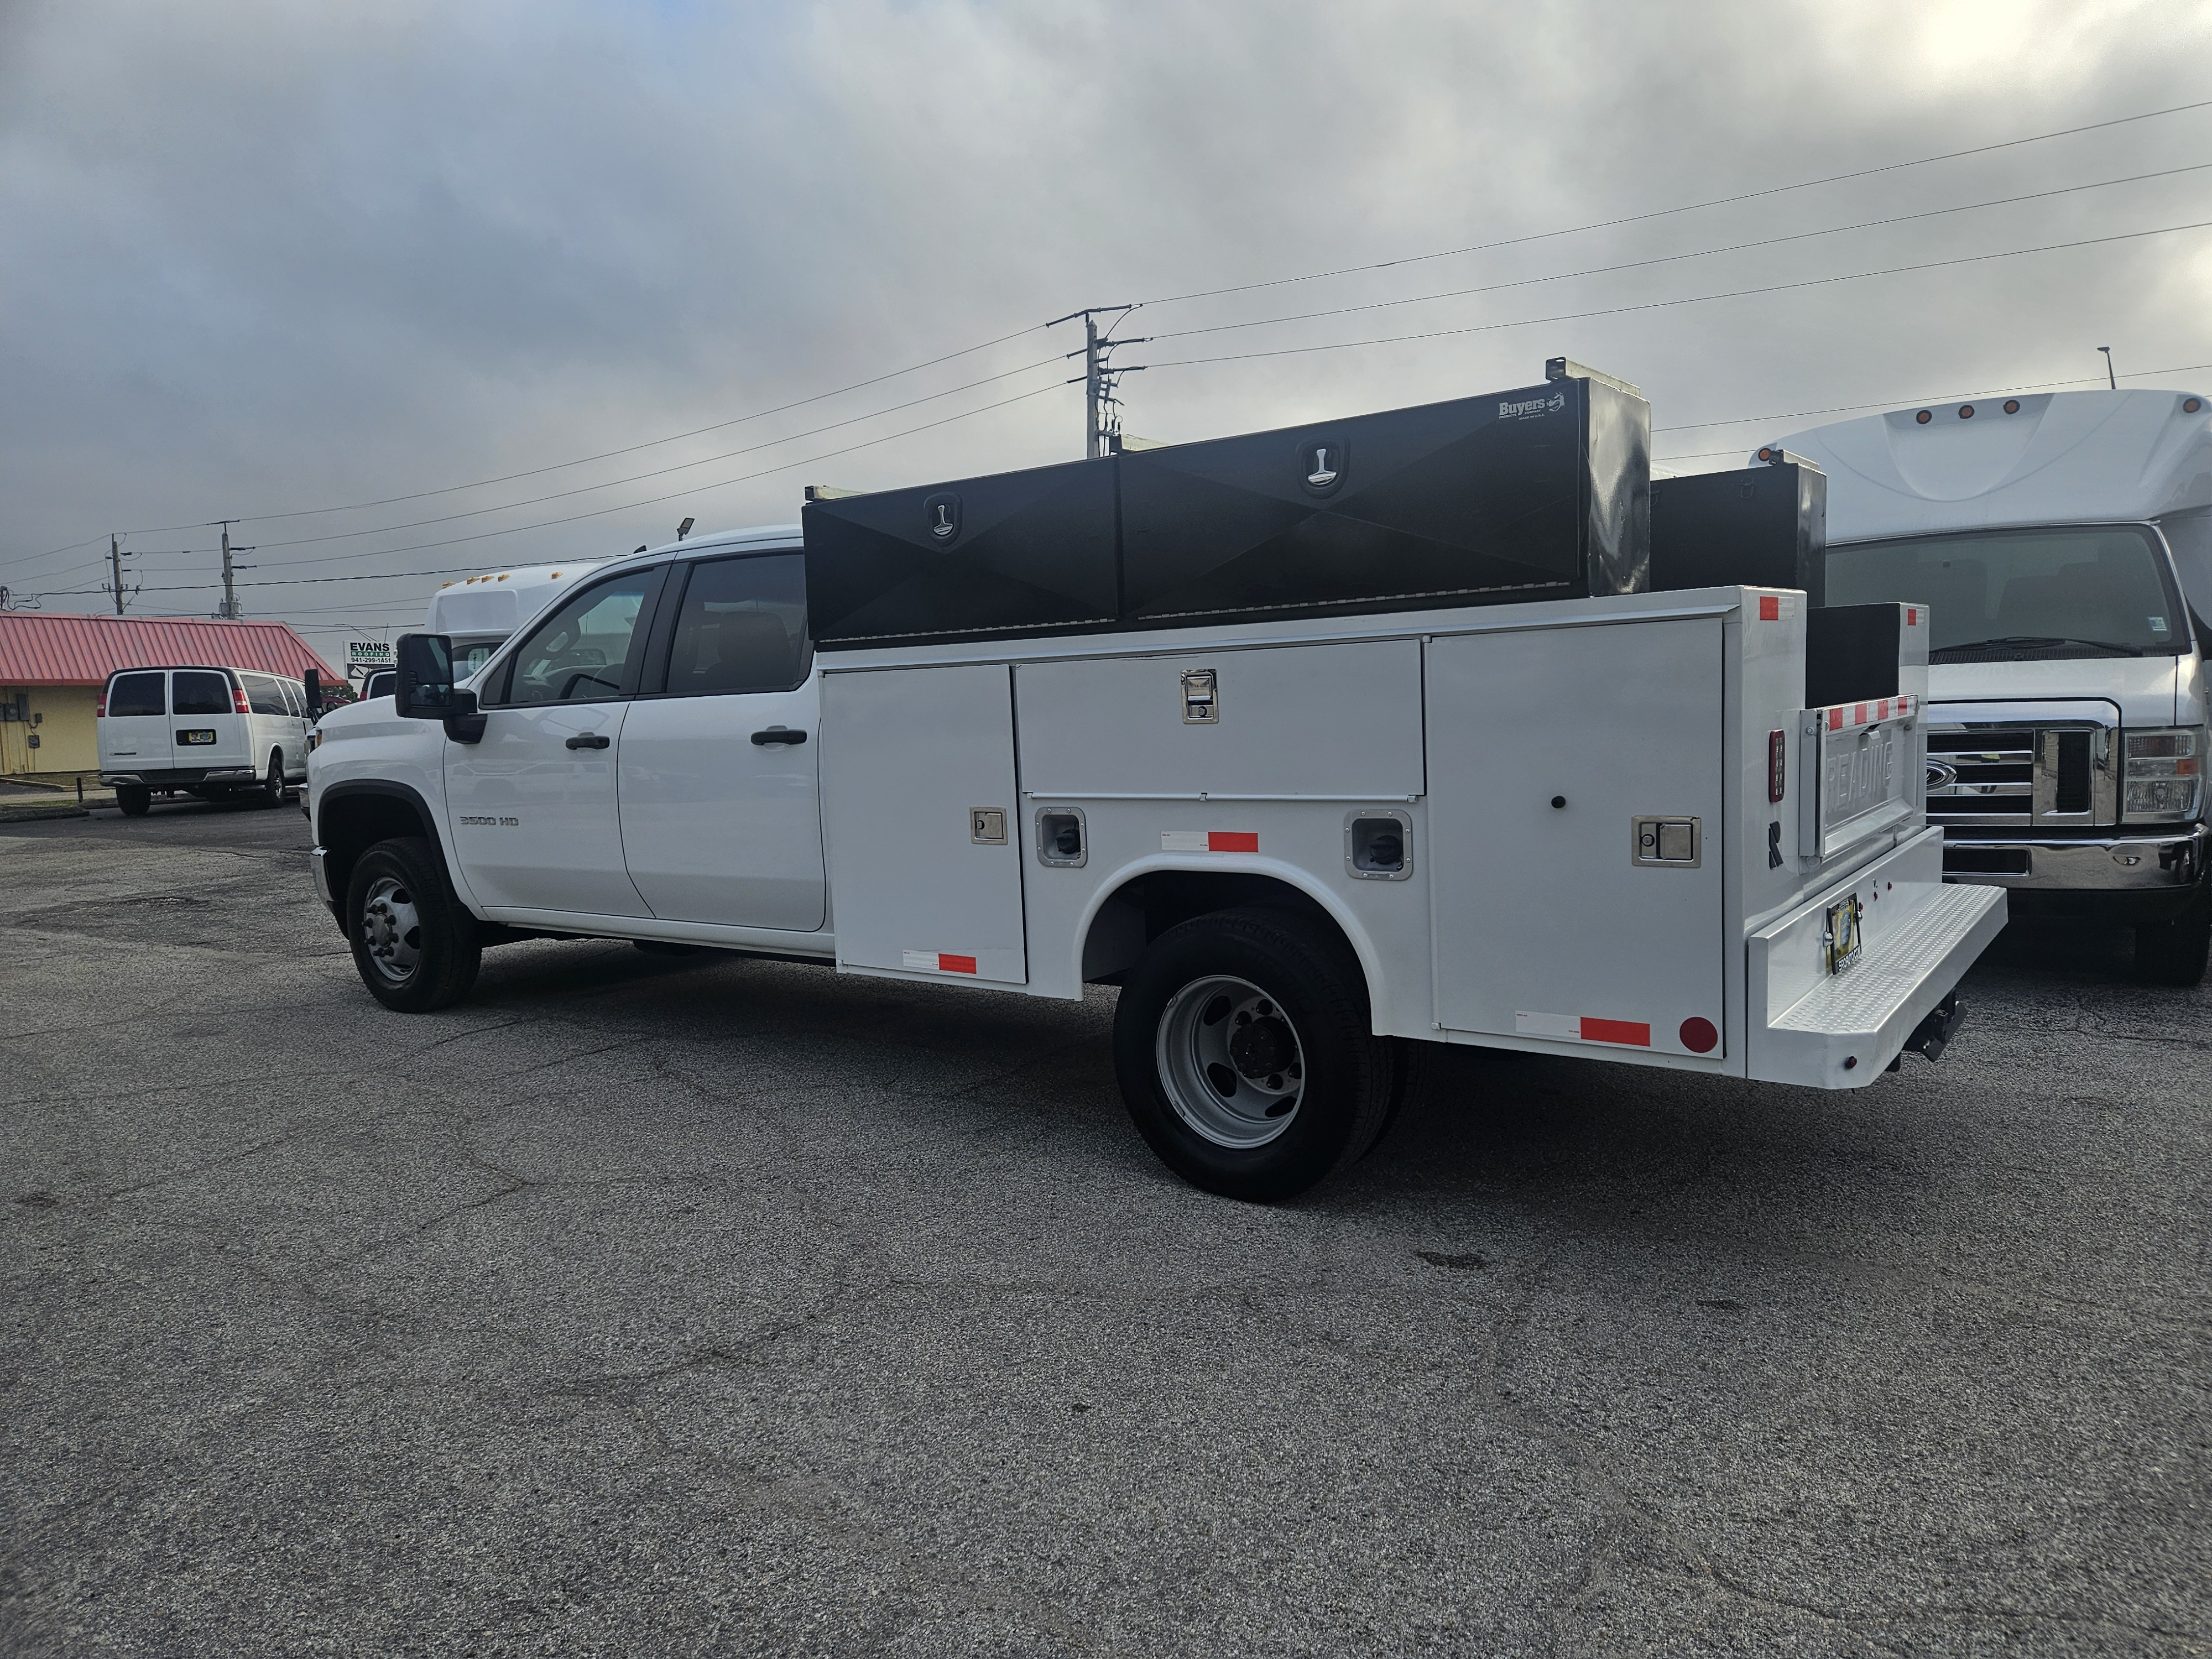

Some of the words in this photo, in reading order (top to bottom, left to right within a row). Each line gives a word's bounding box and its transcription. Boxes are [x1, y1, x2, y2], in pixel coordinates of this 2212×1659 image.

[1499, 399, 1546, 416] Buyers
[350, 642, 390, 651] EVANS
[460, 816, 496, 826] 3500
[499, 817, 519, 826] HD
